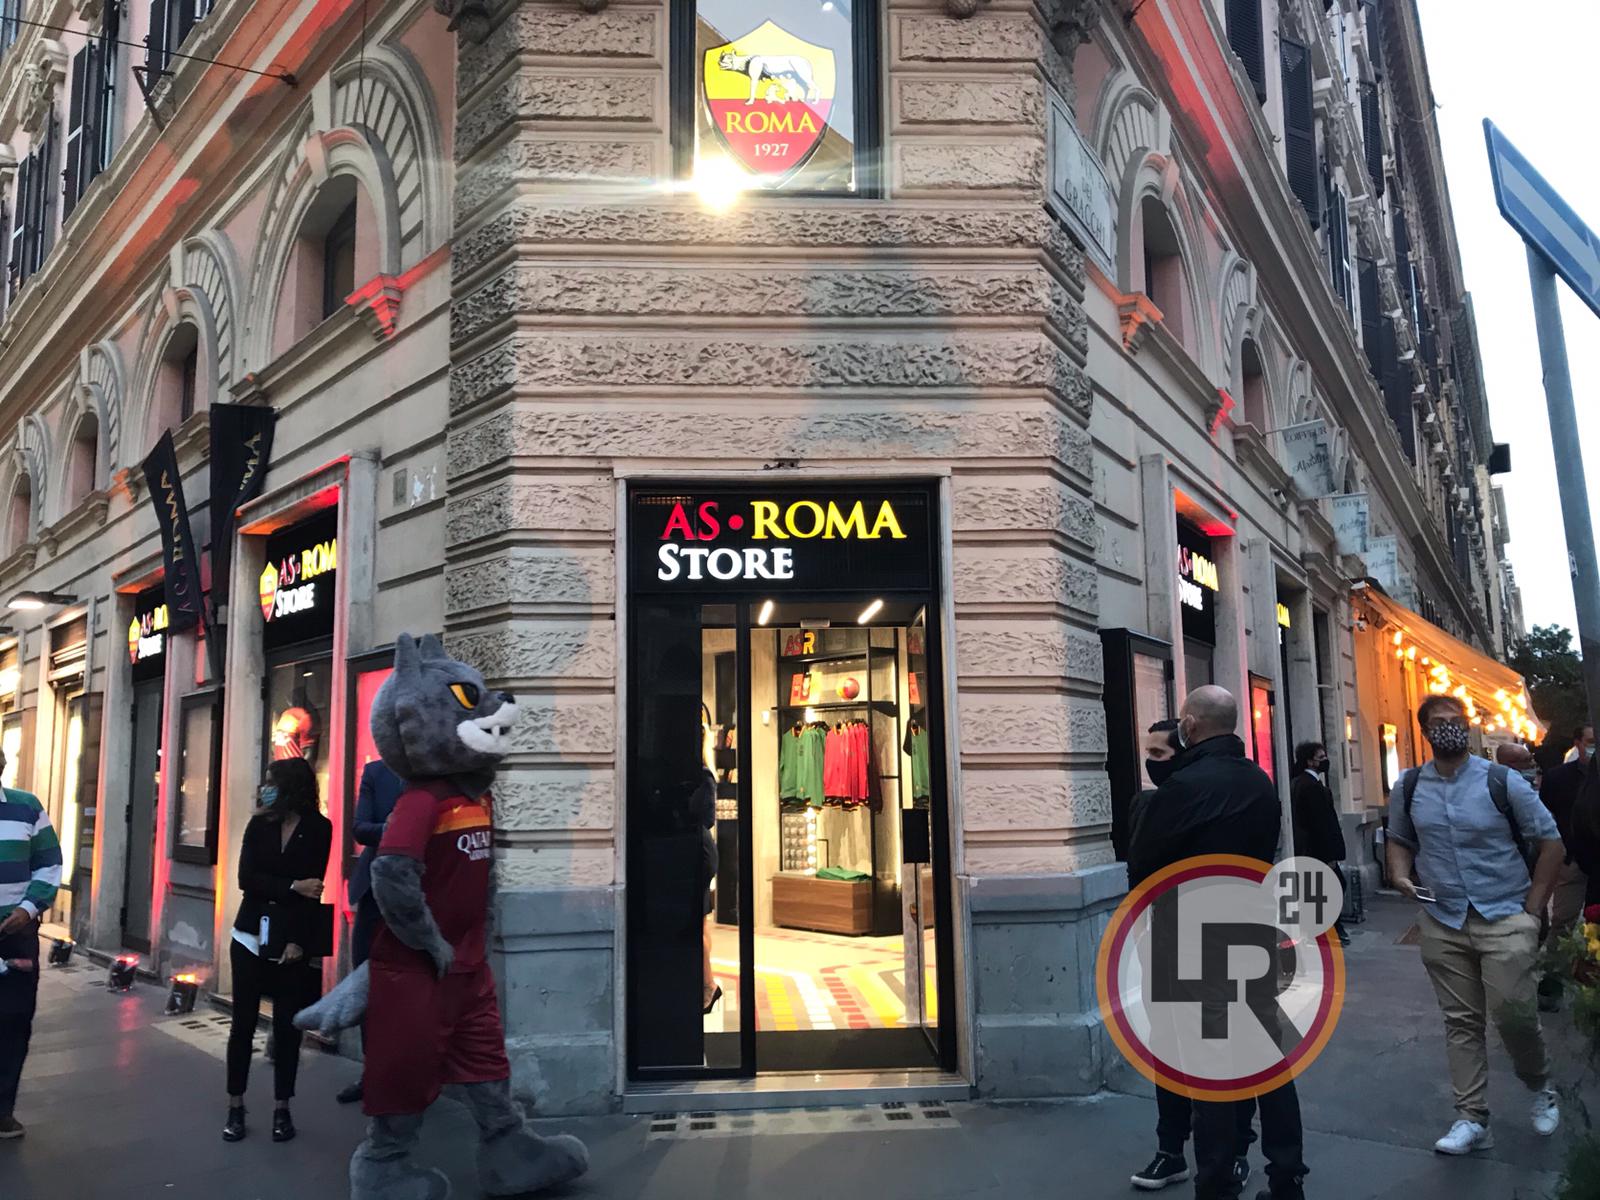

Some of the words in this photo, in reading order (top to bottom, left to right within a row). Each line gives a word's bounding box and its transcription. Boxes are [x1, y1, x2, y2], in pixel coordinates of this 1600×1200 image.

[725, 111, 817, 134] ROMA
[753, 143, 790, 157] 1927
[1064, 177, 1107, 249] GRACCHI
[658, 500, 722, 542] AS
[749, 499, 909, 540] ROMA
[301, 537, 337, 581] ROM
[657, 542, 795, 581] STORE
[153, 603, 169, 632] RO
